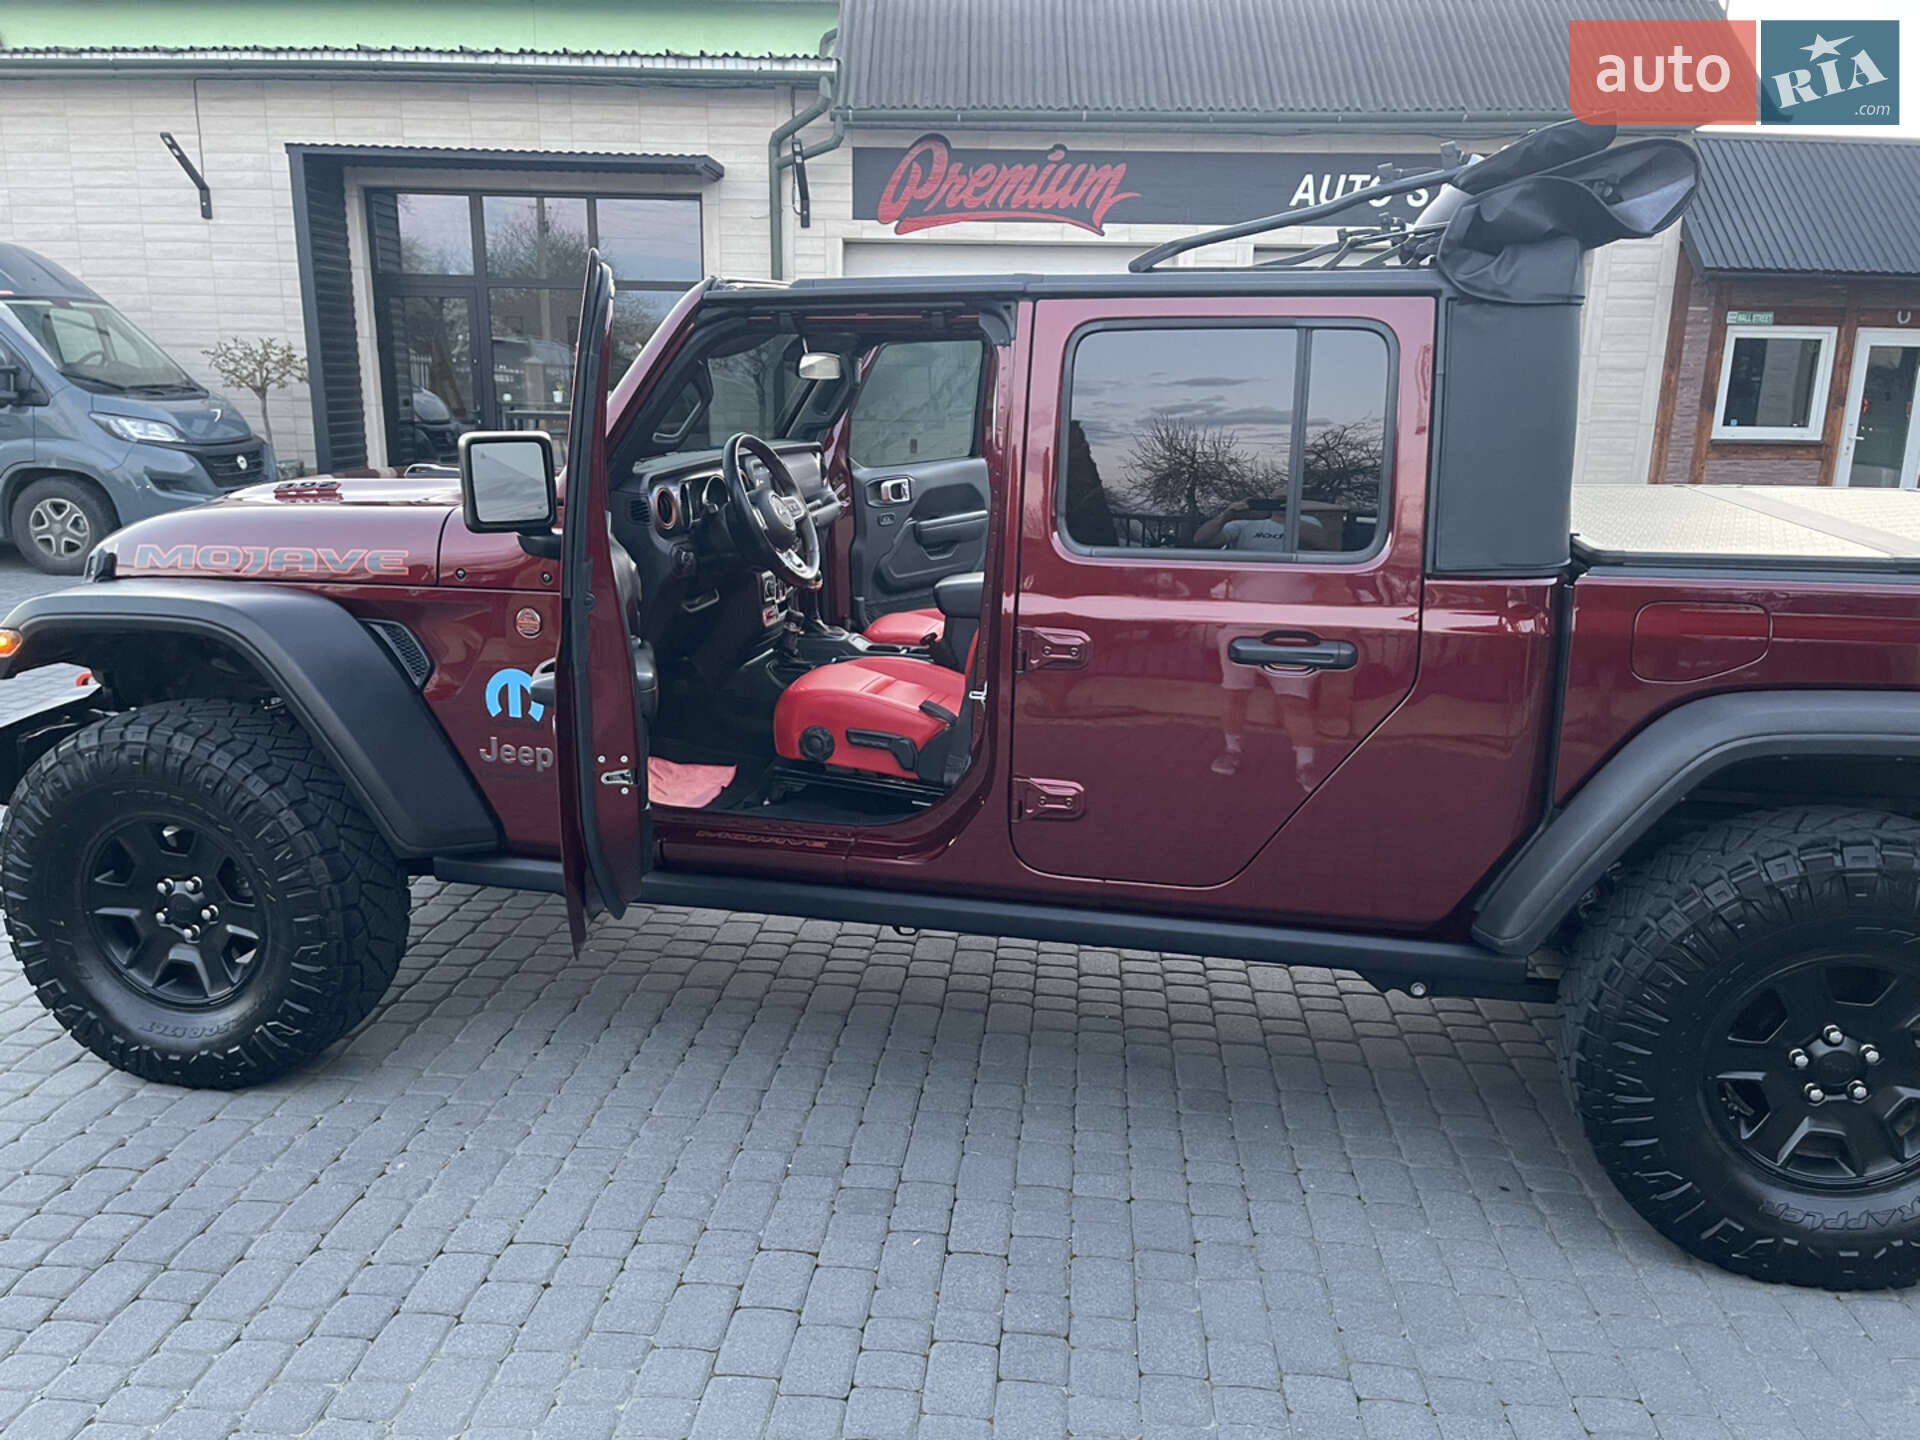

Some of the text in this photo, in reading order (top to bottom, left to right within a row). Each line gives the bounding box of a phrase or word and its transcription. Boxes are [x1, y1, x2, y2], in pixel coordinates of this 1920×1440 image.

[877, 133, 1143, 236] Premium
[134, 544, 409, 576] MOJAVE
[479, 736, 554, 773] Jeep
